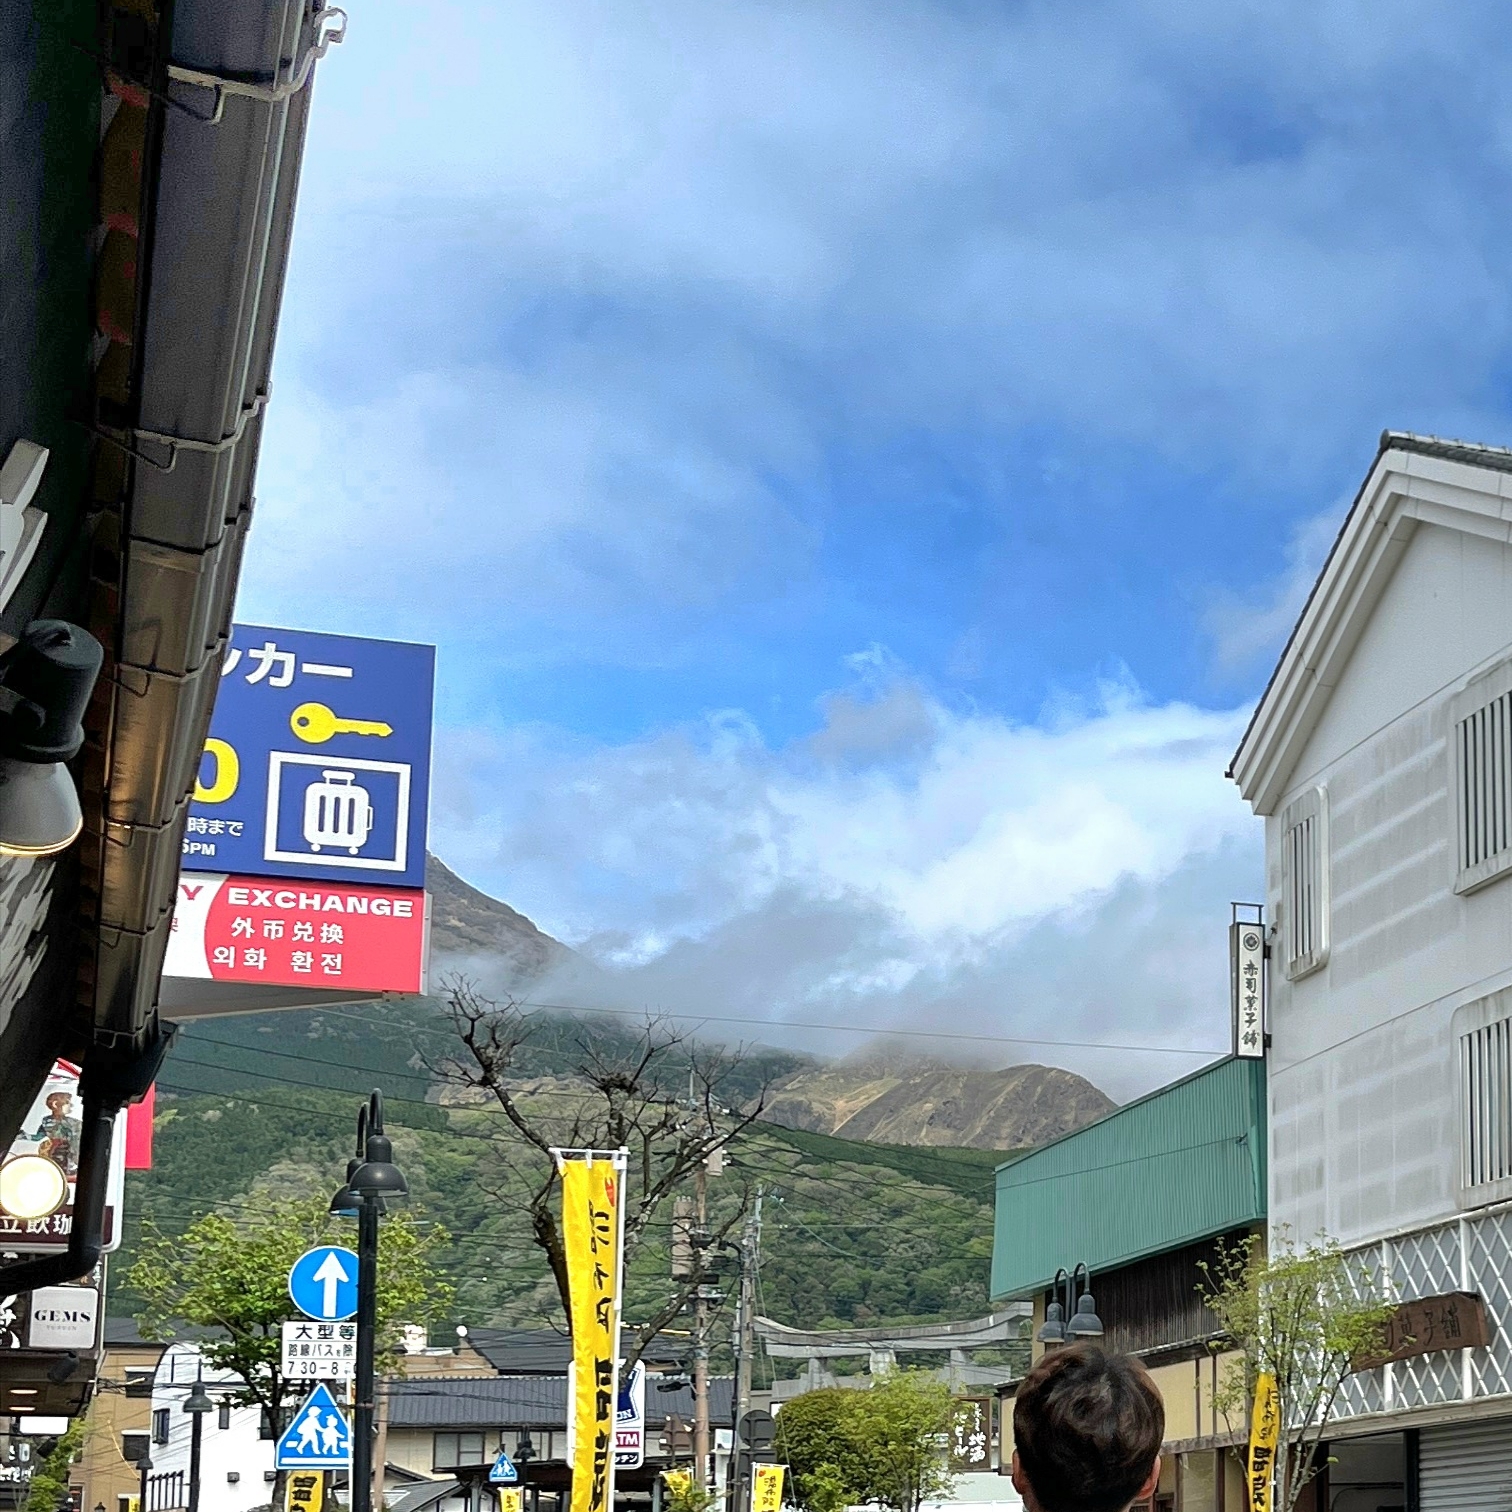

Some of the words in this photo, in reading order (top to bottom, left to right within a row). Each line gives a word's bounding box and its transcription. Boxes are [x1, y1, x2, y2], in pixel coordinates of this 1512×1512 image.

[228, 887, 413, 918] EXCHANGE
[231, 917, 344, 945] 外币兑换
[34, 1310, 91, 1322] GEMS
[295, 1323, 356, 1340] 大型等
[616, 1432, 639, 1446] TM
